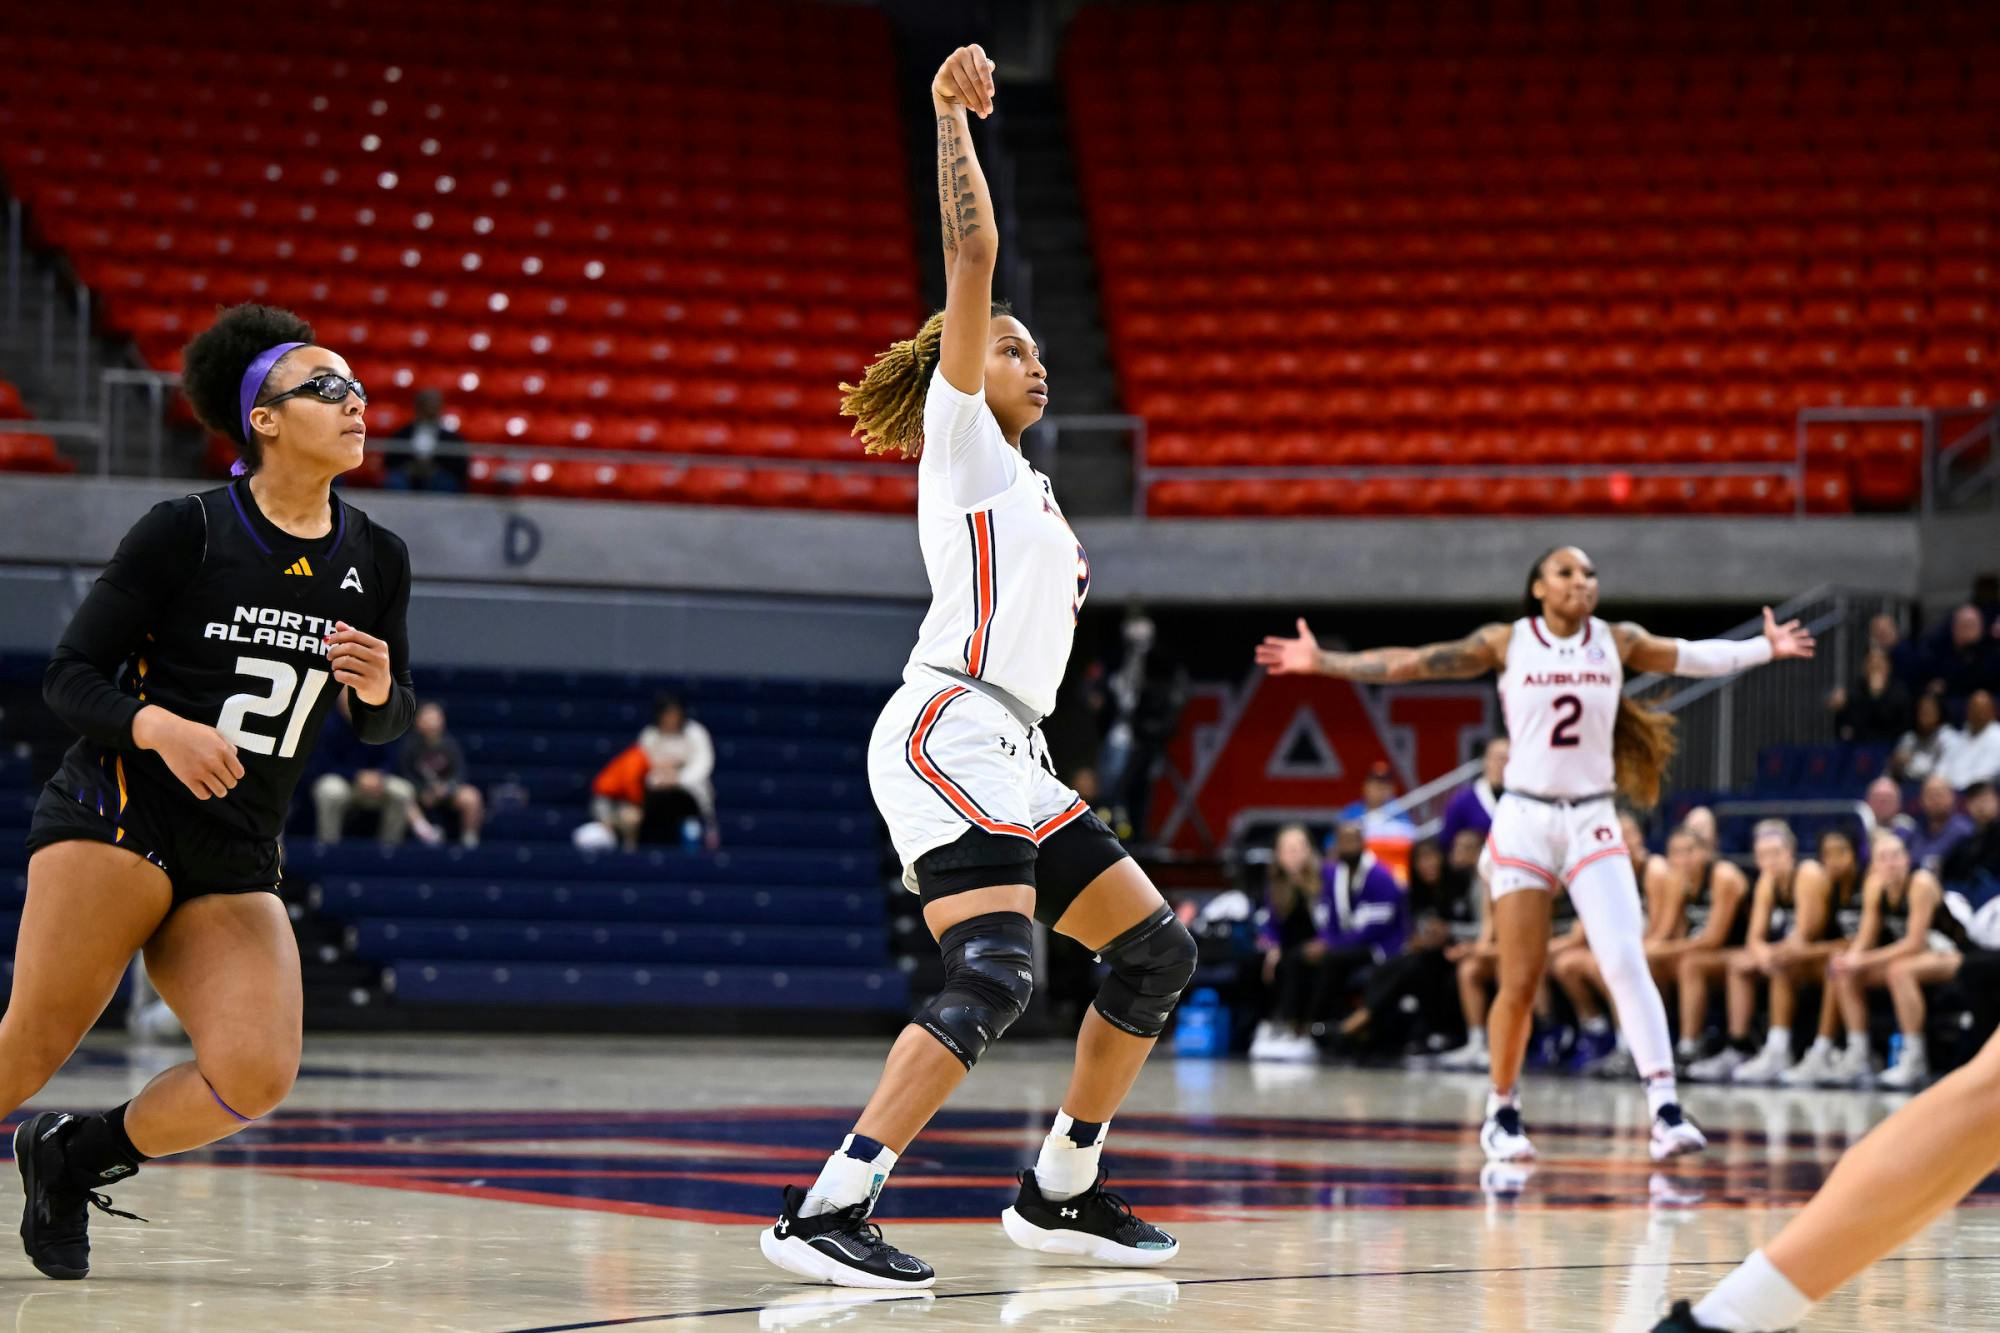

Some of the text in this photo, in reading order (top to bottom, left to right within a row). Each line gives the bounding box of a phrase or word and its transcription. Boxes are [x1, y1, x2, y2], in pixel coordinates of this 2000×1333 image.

[504, 515, 542, 568] D
[1523, 672, 1611, 687] AUBURN
[215, 655, 329, 759] 21
[1550, 693, 1582, 748] 2
